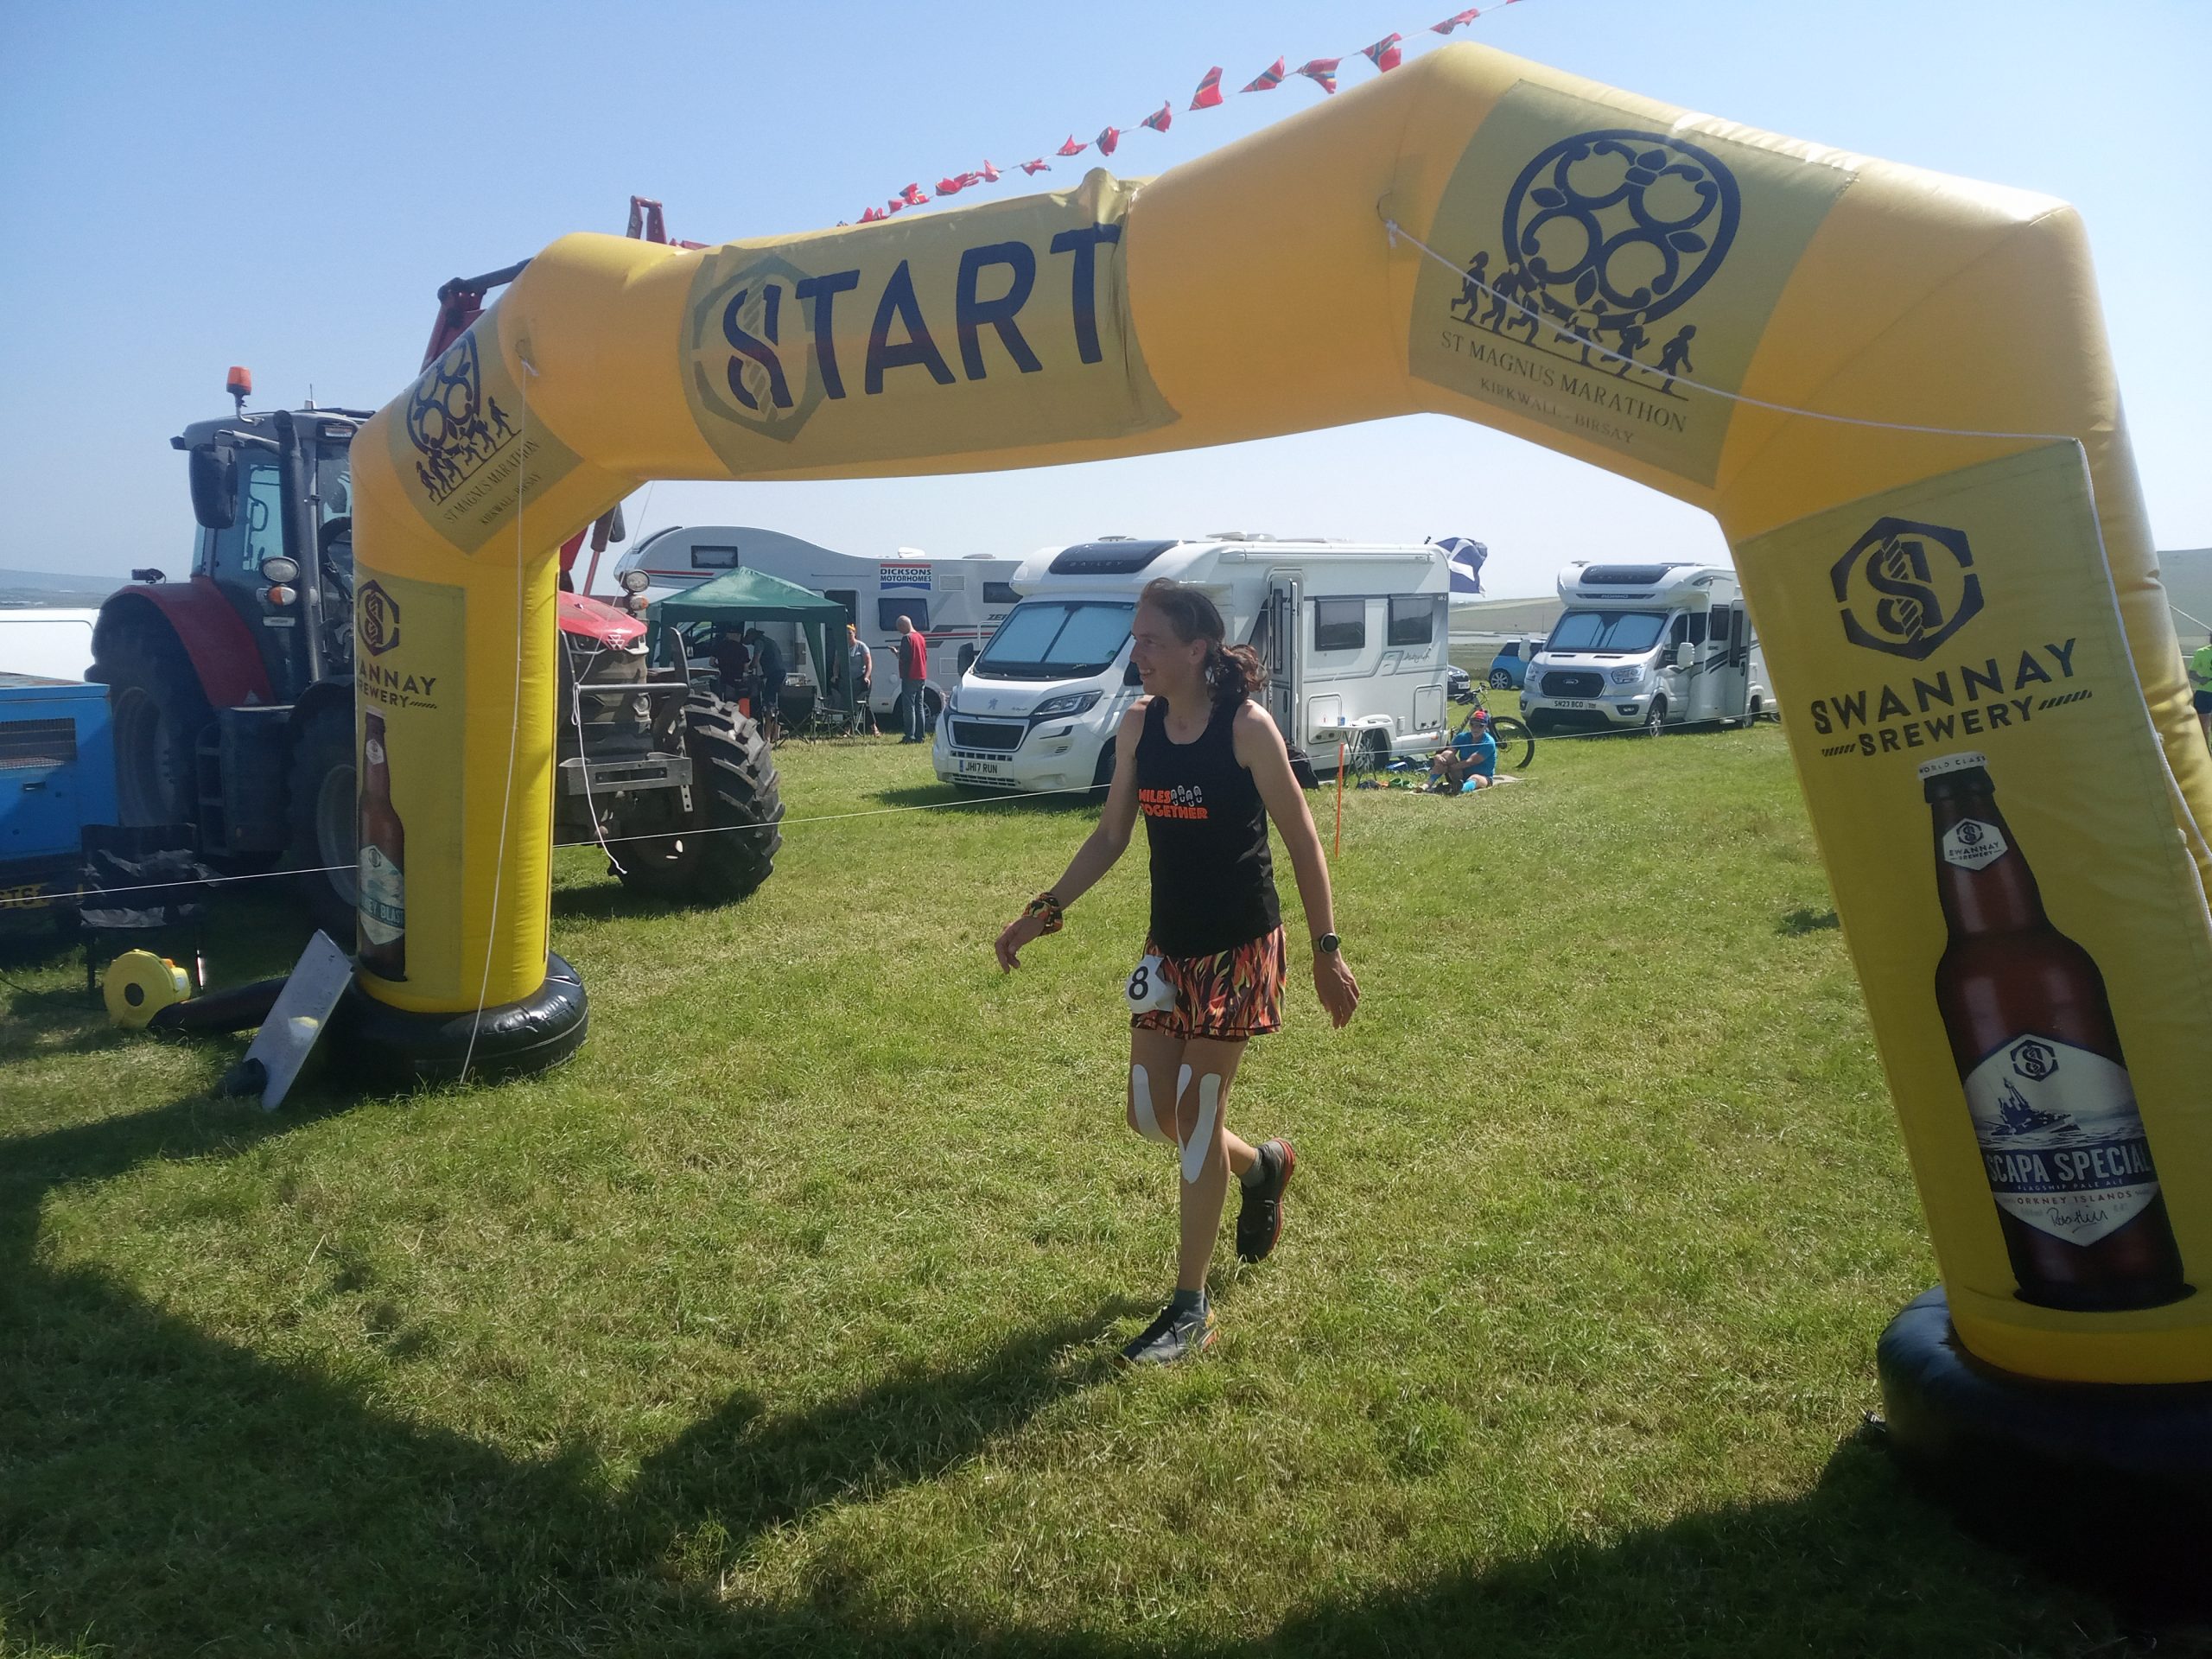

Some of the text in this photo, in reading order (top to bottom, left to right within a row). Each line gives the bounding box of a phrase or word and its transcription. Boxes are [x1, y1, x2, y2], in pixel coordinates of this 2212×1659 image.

[722, 223, 1121, 410] START
[1441, 332, 1687, 433] ST MAGNUS MARATHON
[1481, 378, 1634, 444] KIRKWALL BIRSAY
[454, 480, 492, 513] MAGNUS
[487, 440, 540, 484] MARATHON
[357, 679, 409, 708] REWERY
[358, 659, 436, 696] ANNAY
[1810, 638, 2075, 734] SWANNAY
[982, 763, 998, 773] RUN
[1138, 788, 1171, 804] MILES
[1948, 842, 1999, 856] SWANNAY
[1128, 966, 1148, 1001] 8
[1986, 1154, 2050, 1183] SCAPA
[2017, 1191, 2133, 1205] ORKNEY ISLANDS
